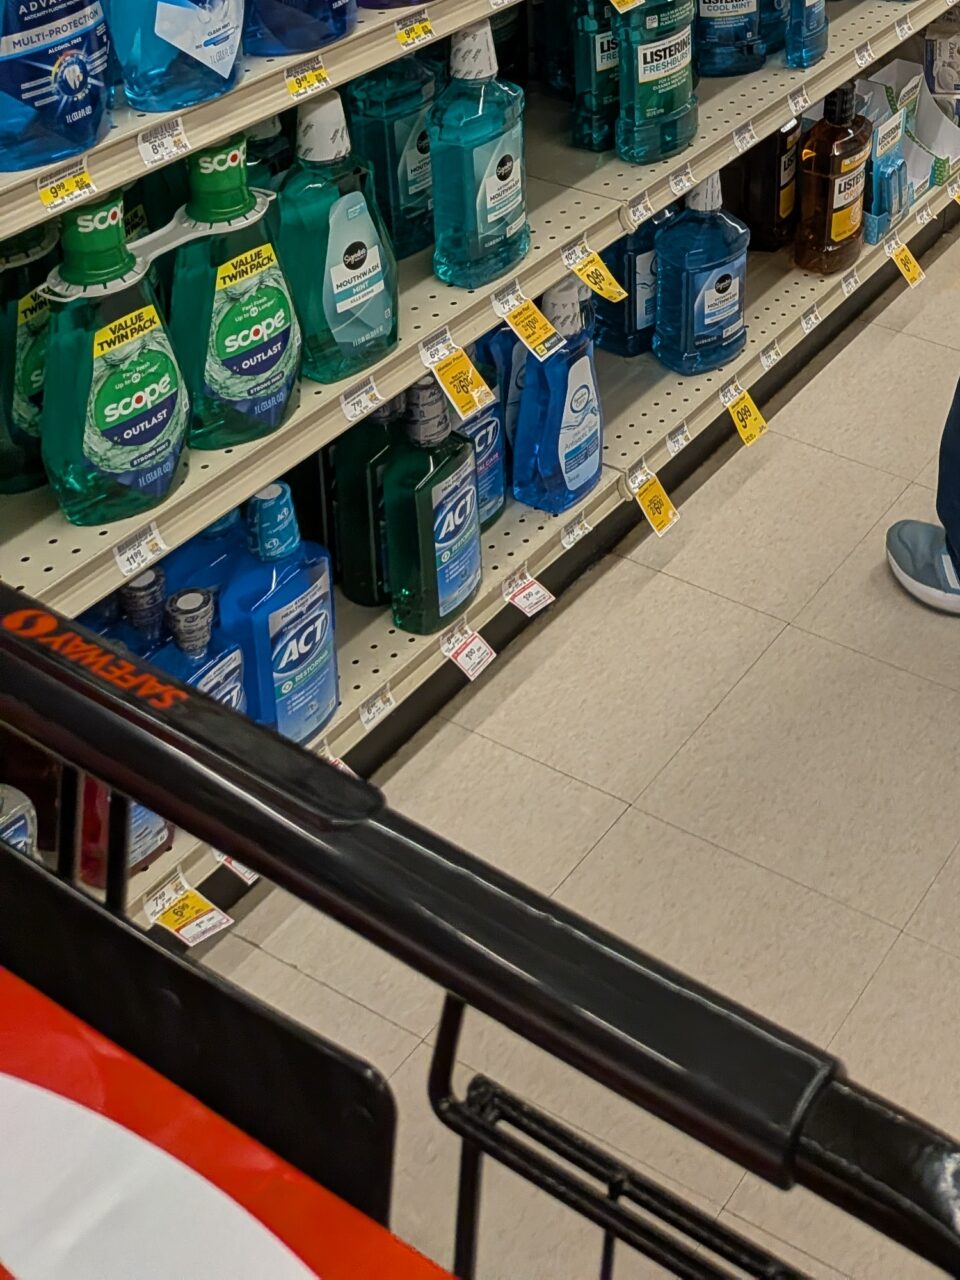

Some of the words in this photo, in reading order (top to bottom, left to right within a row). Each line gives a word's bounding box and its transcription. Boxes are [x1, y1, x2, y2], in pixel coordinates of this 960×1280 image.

[706, 2, 727, 13] COOL
[729, 1, 751, 11] MINT
[12, 9, 100, 49] MULTI-PROTECTION
[642, 33, 691, 64] LISTERINE
[643, 50, 691, 75] FRESHBURST
[50, 182, 65, 198] 999
[489, 178, 521, 202] MOUTHWASH
[220, 267, 248, 285] TWIN
[247, 254, 274, 276] PACK
[231, 249, 263, 271] VALUE
[335, 263, 380, 291] MOUTHWASH
[351, 281, 370, 295] MINT
[586, 269, 605, 293] 999
[97, 331, 129, 353] TWIN
[129, 315, 158, 339] PACK
[108, 311, 145, 336] VALUE
[224, 308, 286, 353] scope
[241, 341, 283, 370] OUTLAST
[105, 372, 171, 424] scope
[123, 409, 168, 440] OUTLAST
[736, 404, 753, 429] 999
[477, 422, 500, 456] CT
[439, 490, 476, 541] ACT
[281, 618, 328, 669] ACT
[48, 632, 189, 710] SAFEWAY
